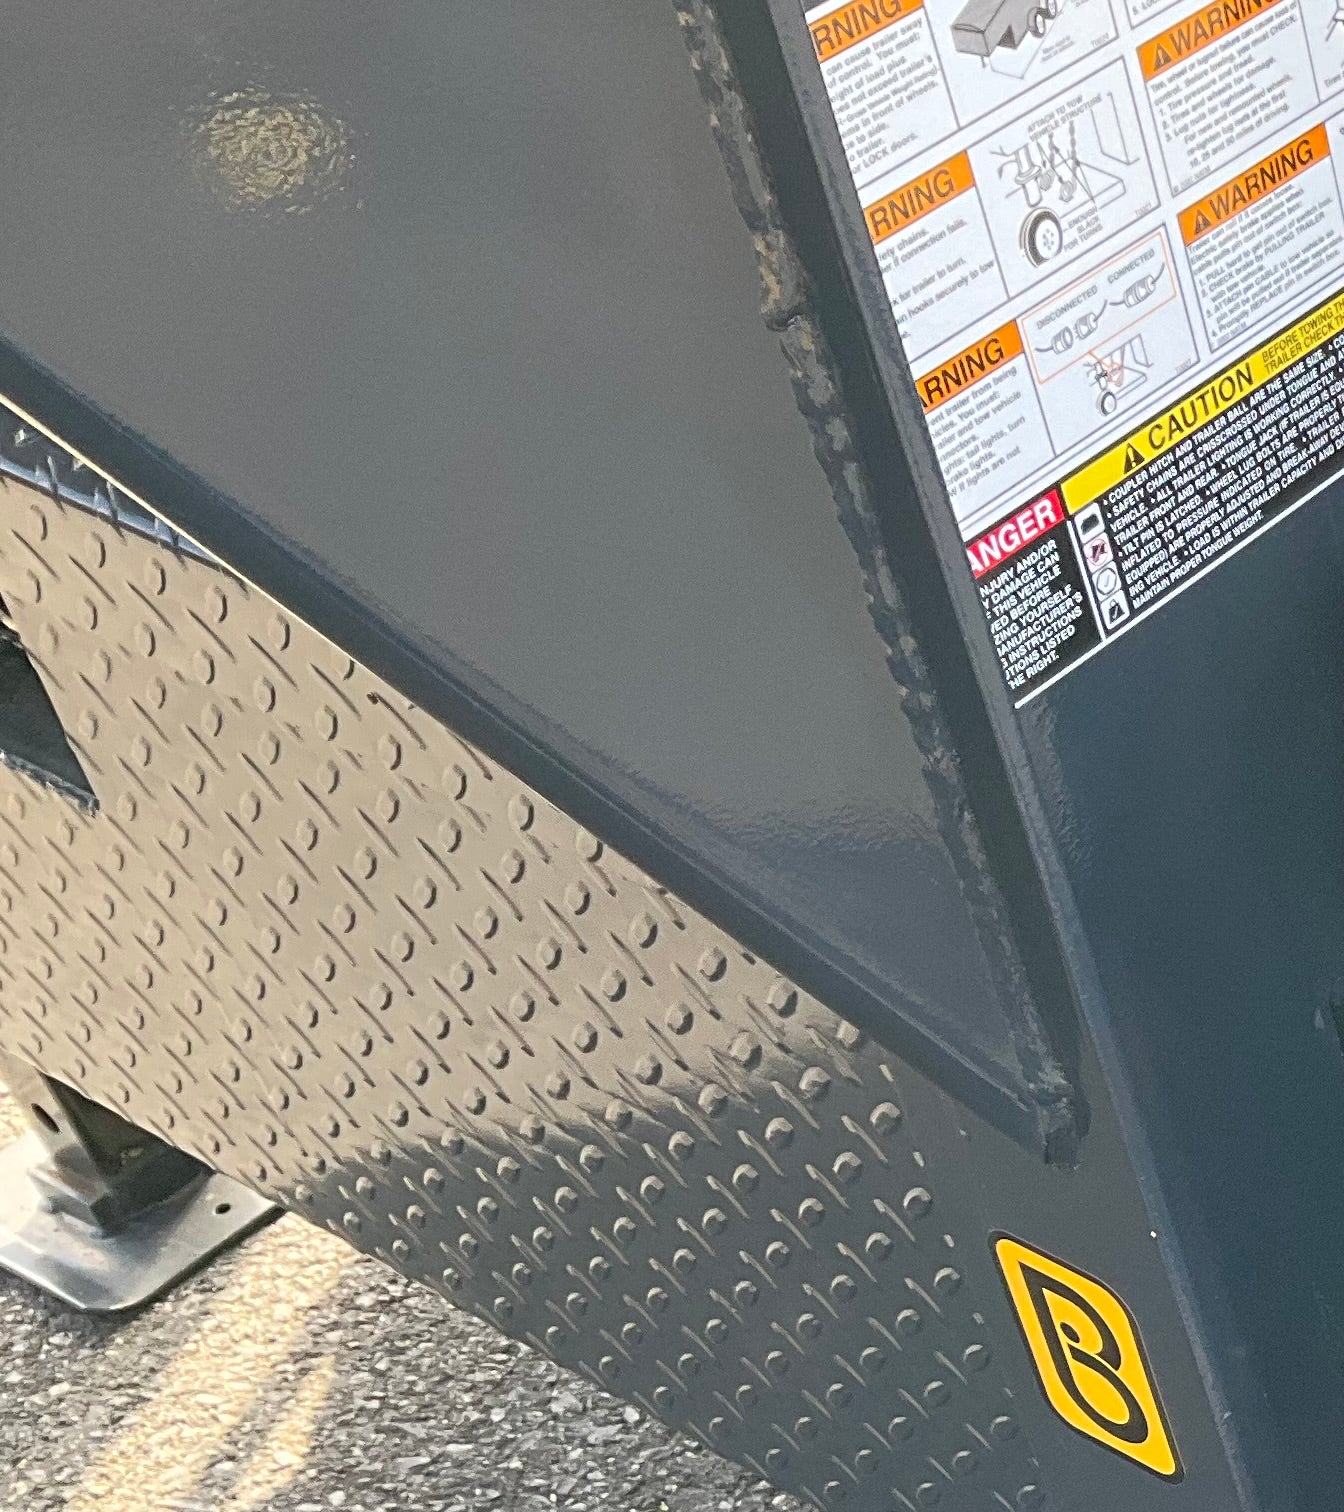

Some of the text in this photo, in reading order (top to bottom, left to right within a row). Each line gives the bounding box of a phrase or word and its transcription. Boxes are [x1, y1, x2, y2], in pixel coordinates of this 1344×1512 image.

[1169, 0, 1274, 57] WARNIN
[1208, 136, 1313, 223] WARNING
[1036, 247, 1155, 330] DISCONNECTED CONNECTED
[1261, 329, 1298, 363] BEFORE
[1298, 306, 1333, 338] TOWING
[1264, 340, 1302, 375] TRAILER
[1303, 319, 1334, 348] CHECK
[1108, 468, 1148, 504] COUPLER
[1148, 451, 1174, 477] HITCH
[1174, 438, 1192, 459] AND
[1192, 415, 1226, 447] TRAILER
[1227, 400, 1247, 423] BALL
[1248, 387, 1266, 408] ARE
[1265, 376, 1283, 396] THE
[1282, 360, 1305, 385] SAME
[1305, 346, 1325, 369] SIZE.
[1112, 485, 1146, 517] SAFETY
[1145, 464, 1177, 494] CHAINS
[1177, 451, 1195, 472] ARE
[1196, 408, 1258, 459] CRISSCROSSED
[1258, 388, 1286, 416] UNDER
[1287, 366, 1318, 396] TONGUE
[1319, 354, 1336, 374] AND
[1146, 361, 1253, 453] CAUTION
[1110, 500, 1148, 534] VEHICLE.
[1155, 483, 1172, 503] ALL
[1171, 459, 1206, 492] TRAILER
[1206, 433, 1243, 467] LIGHTING
[1243, 427, 1252, 441] IS
[1252, 401, 1289, 435] WORKING
[1289, 369, 1336, 409] CORRECTLY.
[1114, 514, 1149, 547] TRAILER
[1148, 495, 1176, 523] FRONT
[1176, 482, 1194, 503] AND
[1194, 465, 1219, 491] REAR.
[1224, 438, 1257, 469] TONGUE
[1257, 424, 1278, 446] JACK
[1278, 415, 1291, 433] (IF
[1289, 394, 1320, 424] TRAILER
[1320, 388, 1329, 402] IS
[1121, 536, 1162, 572] INFLATED
[1162, 527, 1174, 543] TO
[1175, 495, 1219, 534] PRESSURE
[1220, 465, 1262, 502] INDICATED
[1263, 455, 1276, 472] ON
[1277, 439, 1298, 462] TIRE.
[1307, 410, 1340, 441] TRAILER
[990, 549, 1060, 605] DAMAGE CAN
[1015, 537, 1056, 574] AND/OR
[1131, 508, 1263, 610] MAINTAIN PROPER TONGUE WEIGHT.
[992, 563, 1061, 619] THIS VEHICLE
[1009, 584, 1050, 620] BEFORE
[1019, 583, 1072, 628] YOURSELF
[1008, 604, 1082, 664] INSTRUCTIONS
[1039, 623, 1075, 656] LISTED
[1025, 648, 1059, 679] RIGHT.
